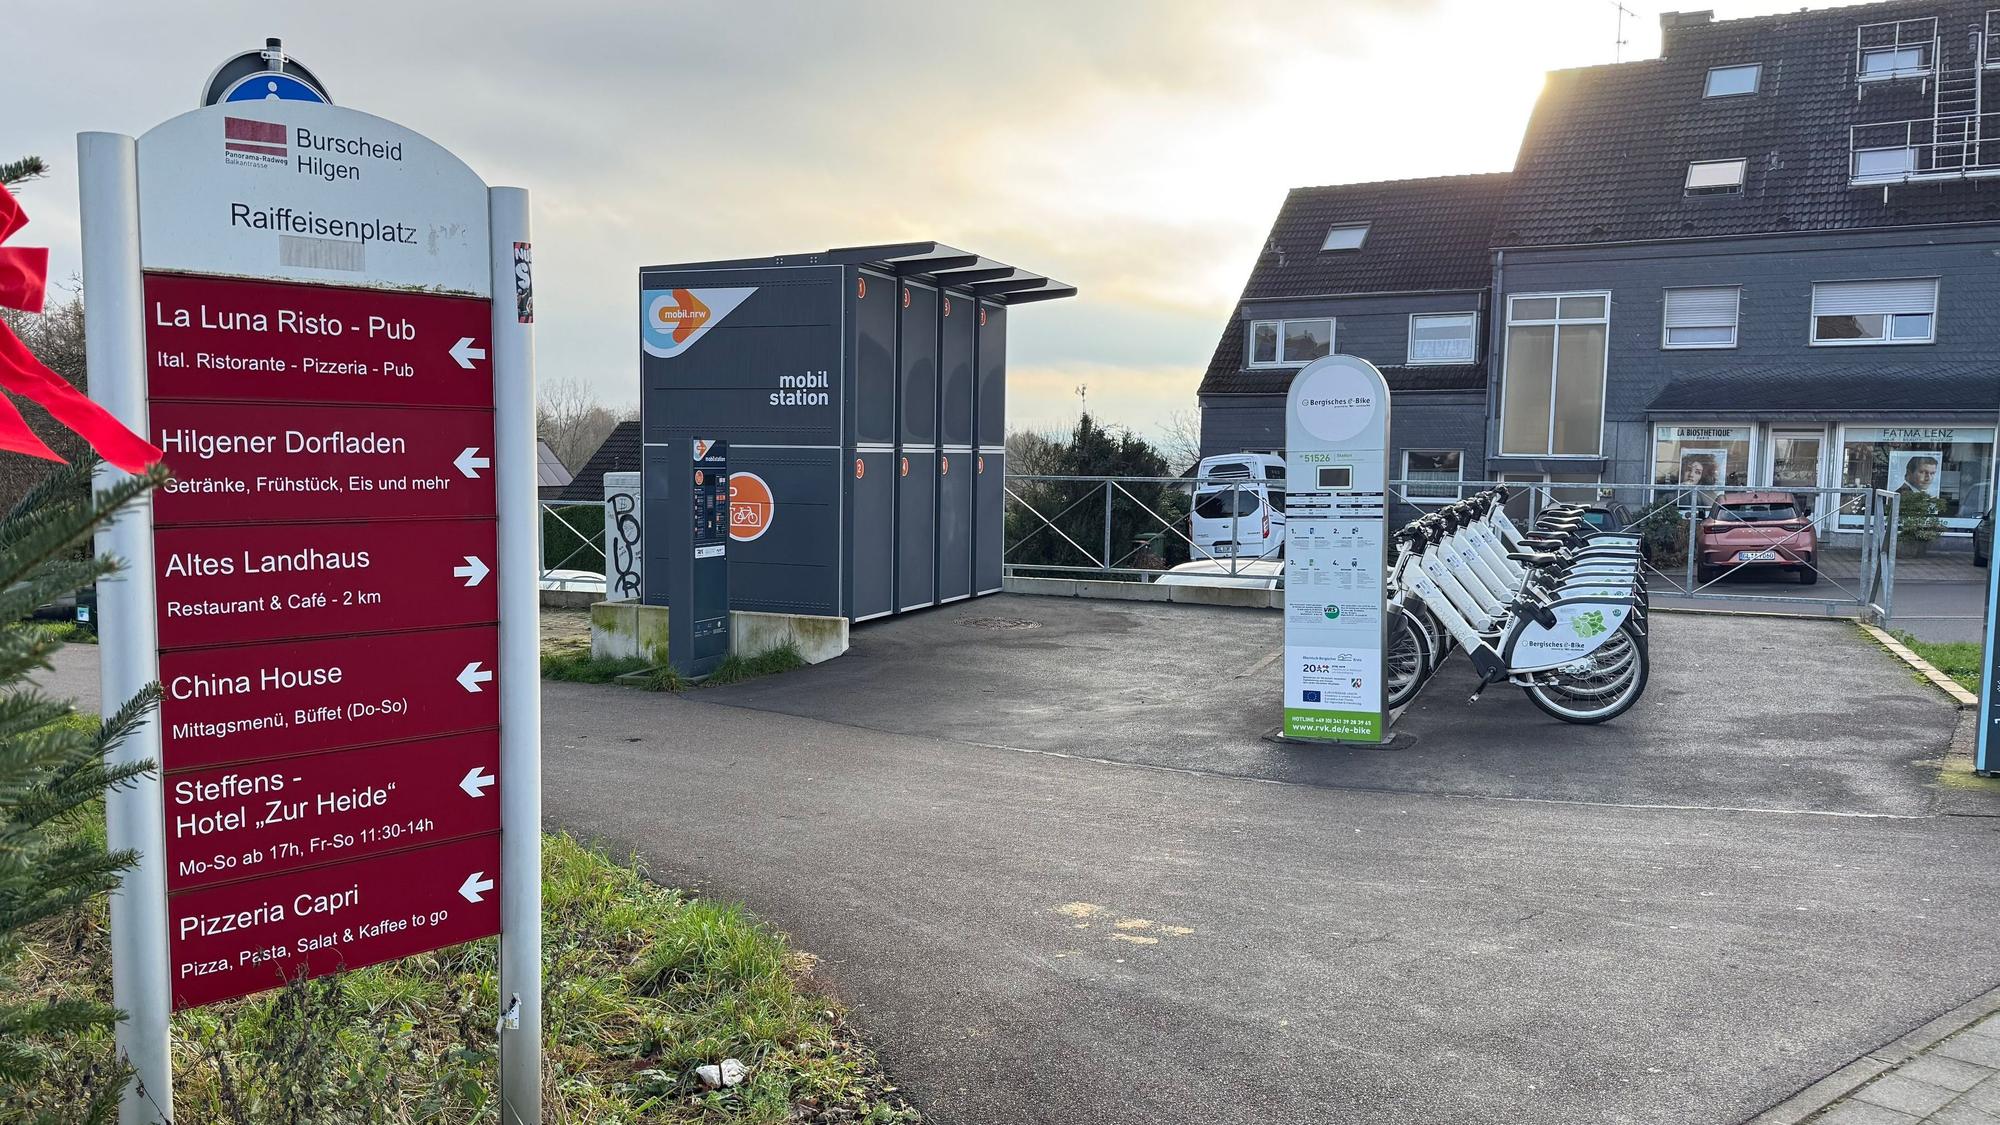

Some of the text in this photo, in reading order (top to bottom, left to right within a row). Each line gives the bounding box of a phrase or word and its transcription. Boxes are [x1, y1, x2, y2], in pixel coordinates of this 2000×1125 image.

[297, 127, 402, 161] Burscheid
[225, 151, 288, 166] Panorama-Radweg
[225, 158, 268, 169] Balkantrasse
[298, 155, 360, 182] Hilgen
[231, 203, 418, 245] Raiffeisenplatz
[156, 301, 191, 327] La
[201, 304, 268, 332] Luna
[278, 309, 343, 336] Risto
[368, 315, 416, 341] Pub
[664, 309, 707, 319] mobil.nrw
[158, 351, 190, 368] Ital.
[196, 352, 286, 372] Ristorante
[303, 357, 368, 375] Pizzeria
[383, 361, 414, 377] Pub
[779, 371, 829, 388] mobil
[769, 389, 829, 406] station
[1310, 398, 1347, 407] Bergisches
[161, 428, 406, 459] Hilgener Dorfladen
[1677, 429, 1685, 437] LA
[1883, 429, 1954, 438] FATMA LENZ
[1304, 454, 1331, 463] 51526
[163, 475, 450, 495] Getränke, Frühstück, Eis und mehr
[165, 548, 370, 577] Altes Landhaus
[167, 597, 264, 618] Restaurant
[269, 595, 283, 611] &
[288, 592, 327, 609] Café
[343, 591, 353, 606] 2
[358, 590, 381, 604] km
[1529, 640, 1563, 649] Bergisches
[171, 666, 342, 700] China House
[173, 698, 408, 740] Mittagsmenü, Büffet (Do-So)
[1292, 724, 1371, 735] www.rvk.de/e-bike
[175, 773, 284, 805] Steffens
[176, 781, 397, 838] Hotel „Zur Heide“
[179, 818, 434, 877] Mo-So ab 17h, Fr-So 11:30-14h
[179, 883, 359, 941] Pizzeria Capri
[181, 909, 449, 979] Pizza, Pasta, Salat & Kaffee to go
